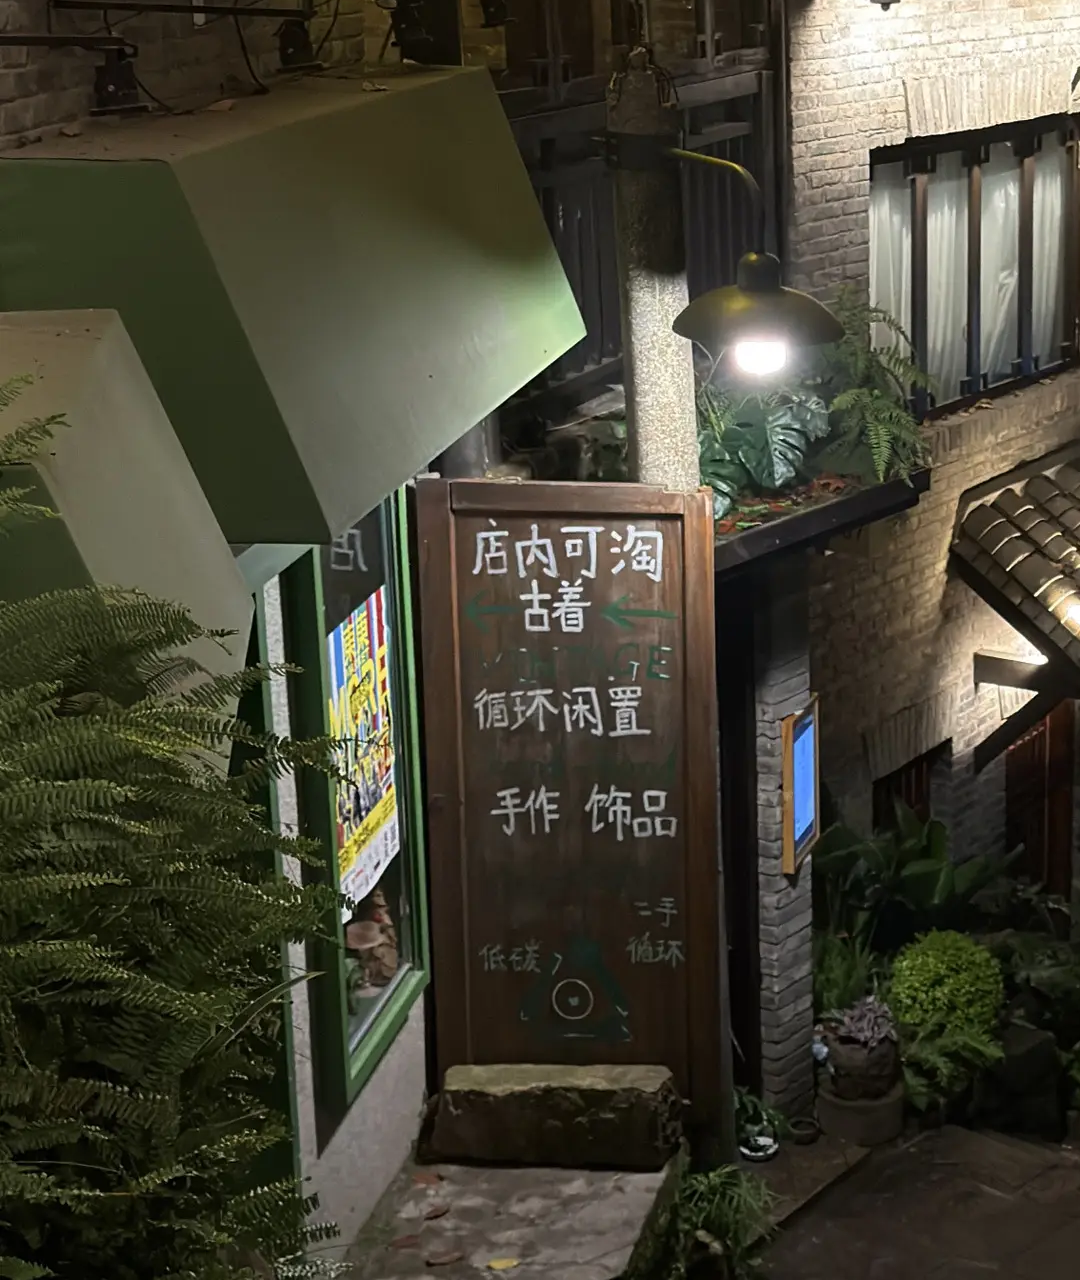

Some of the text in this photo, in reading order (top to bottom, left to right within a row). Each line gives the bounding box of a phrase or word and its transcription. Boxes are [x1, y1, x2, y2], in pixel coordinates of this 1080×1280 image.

[471, 518, 664, 583] 店内可淘
[519, 578, 592, 633] 古着
[473, 686, 652, 738] 循环闲置
[490, 782, 679, 842] 手作 饰品
[633, 896, 679, 928] 二手
[478, 938, 542, 973] 低碳
[626, 931, 686, 969] 循环
